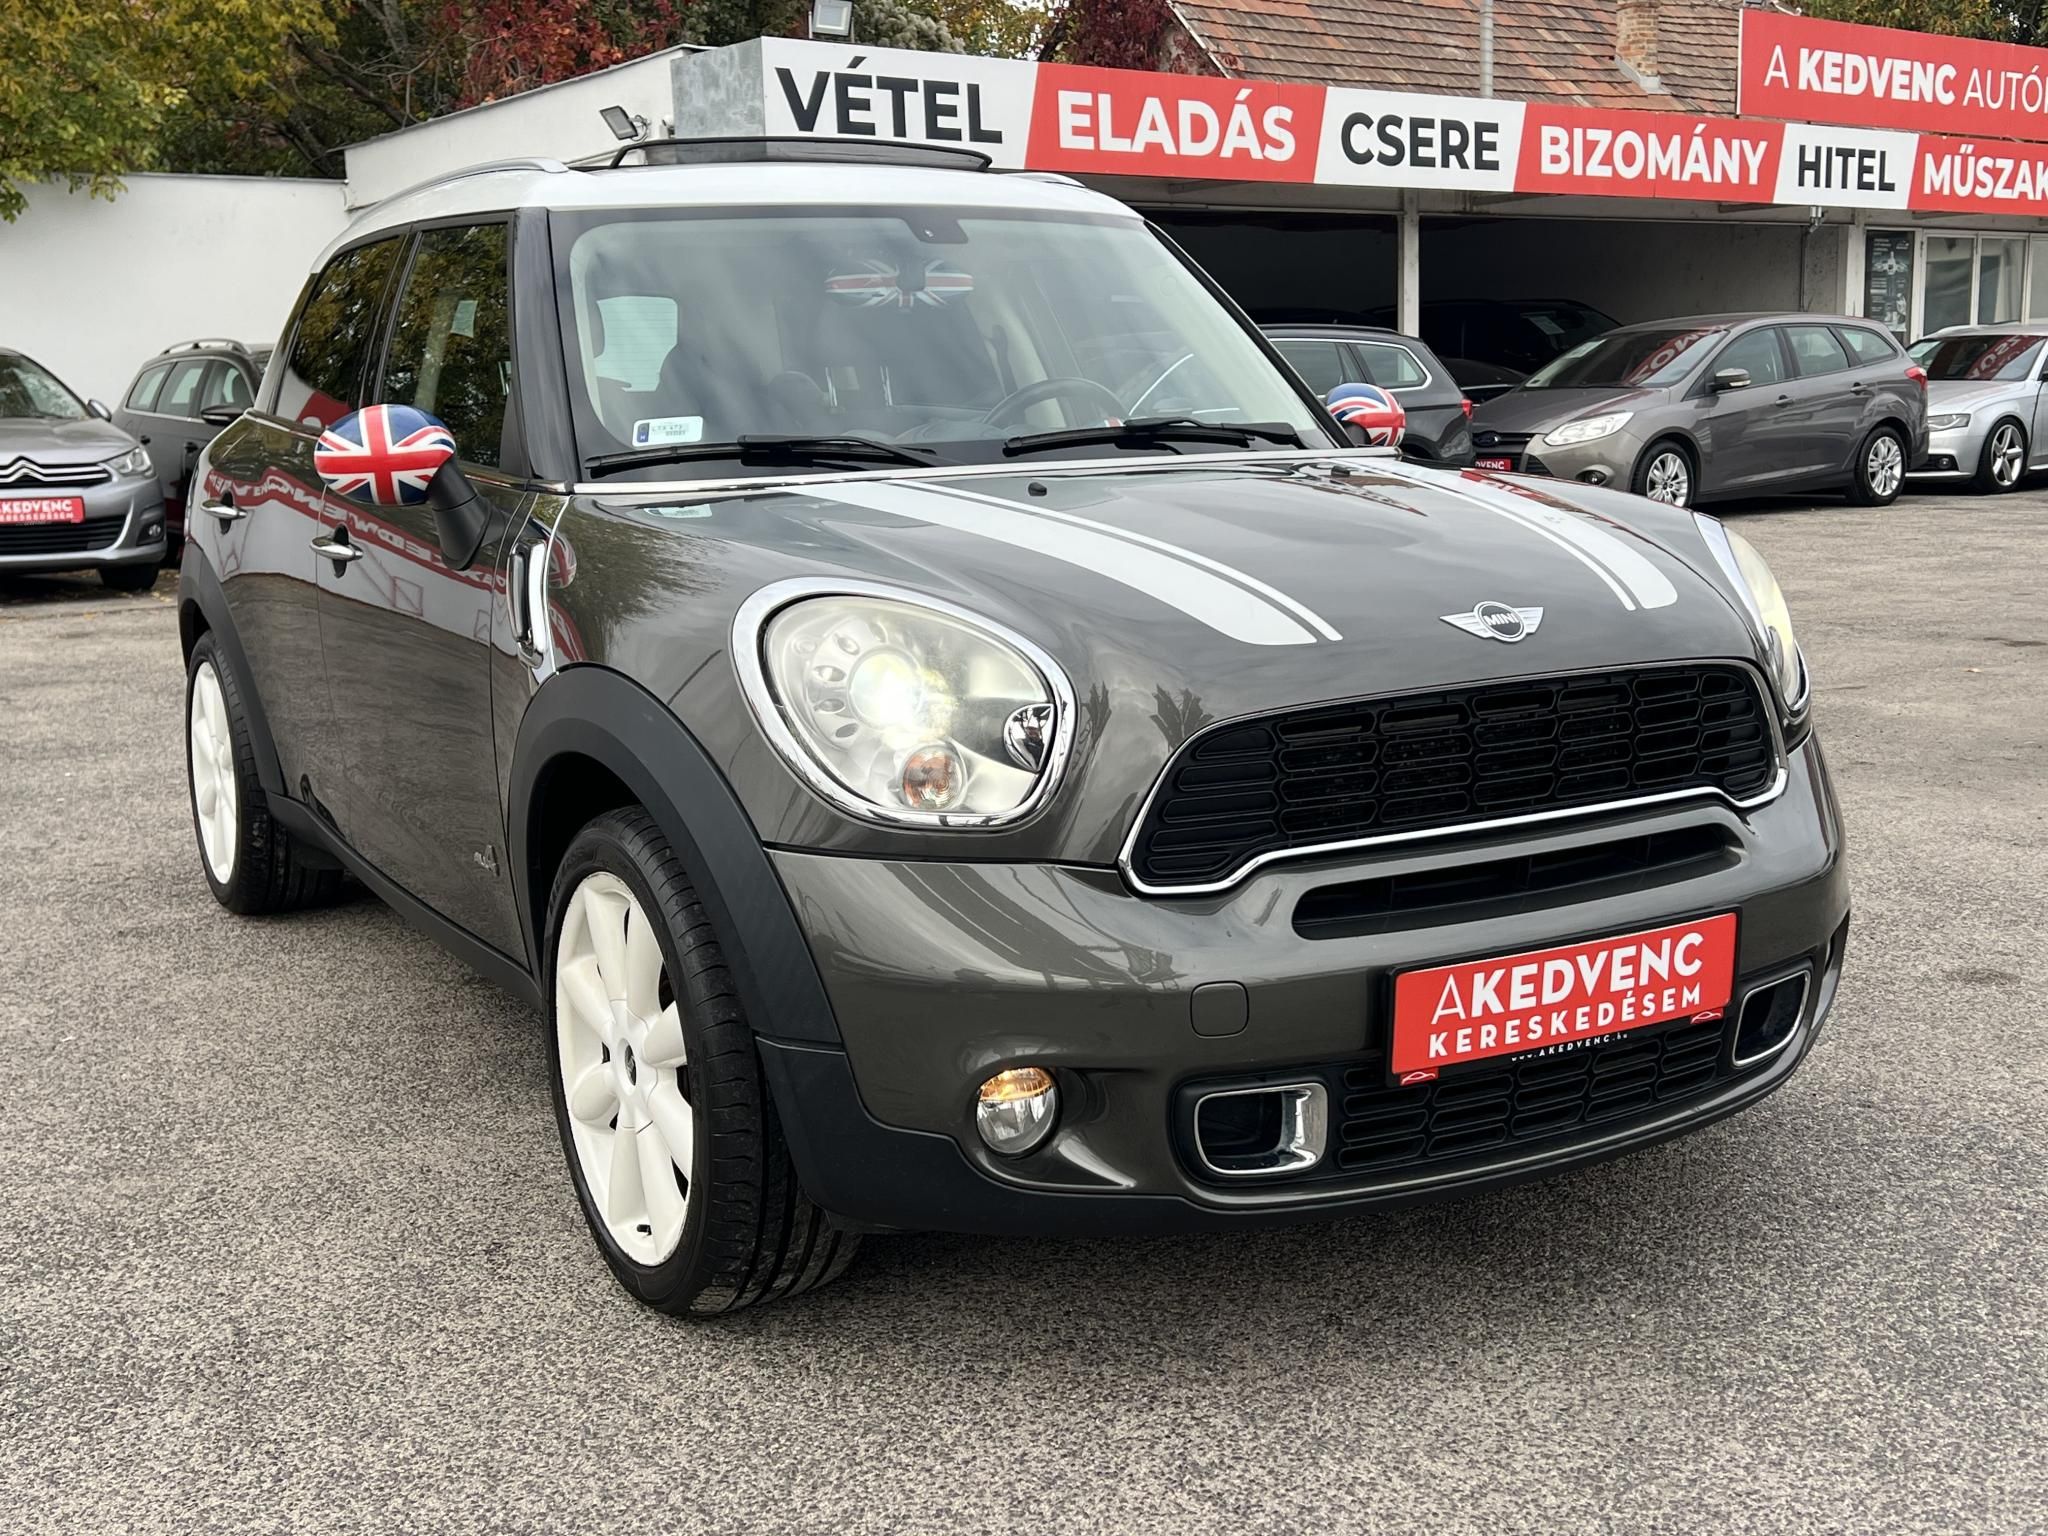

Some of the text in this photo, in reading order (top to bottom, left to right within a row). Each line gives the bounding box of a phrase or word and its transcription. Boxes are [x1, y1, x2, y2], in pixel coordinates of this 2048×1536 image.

[775, 55, 1003, 145] VÉTEL
[1763, 44, 2048, 114] A KEDVENC AUTÓ
[1057, 87, 1296, 162] ELADÁS
[1340, 111, 1500, 171] CSERE
[1539, 122, 1768, 186] BIZOMÁNY
[1797, 144, 1896, 192] HITEL
[1482, 612, 1521, 626] MINI
[1428, 981, 1701, 1059] KERESKEDÉSEM
